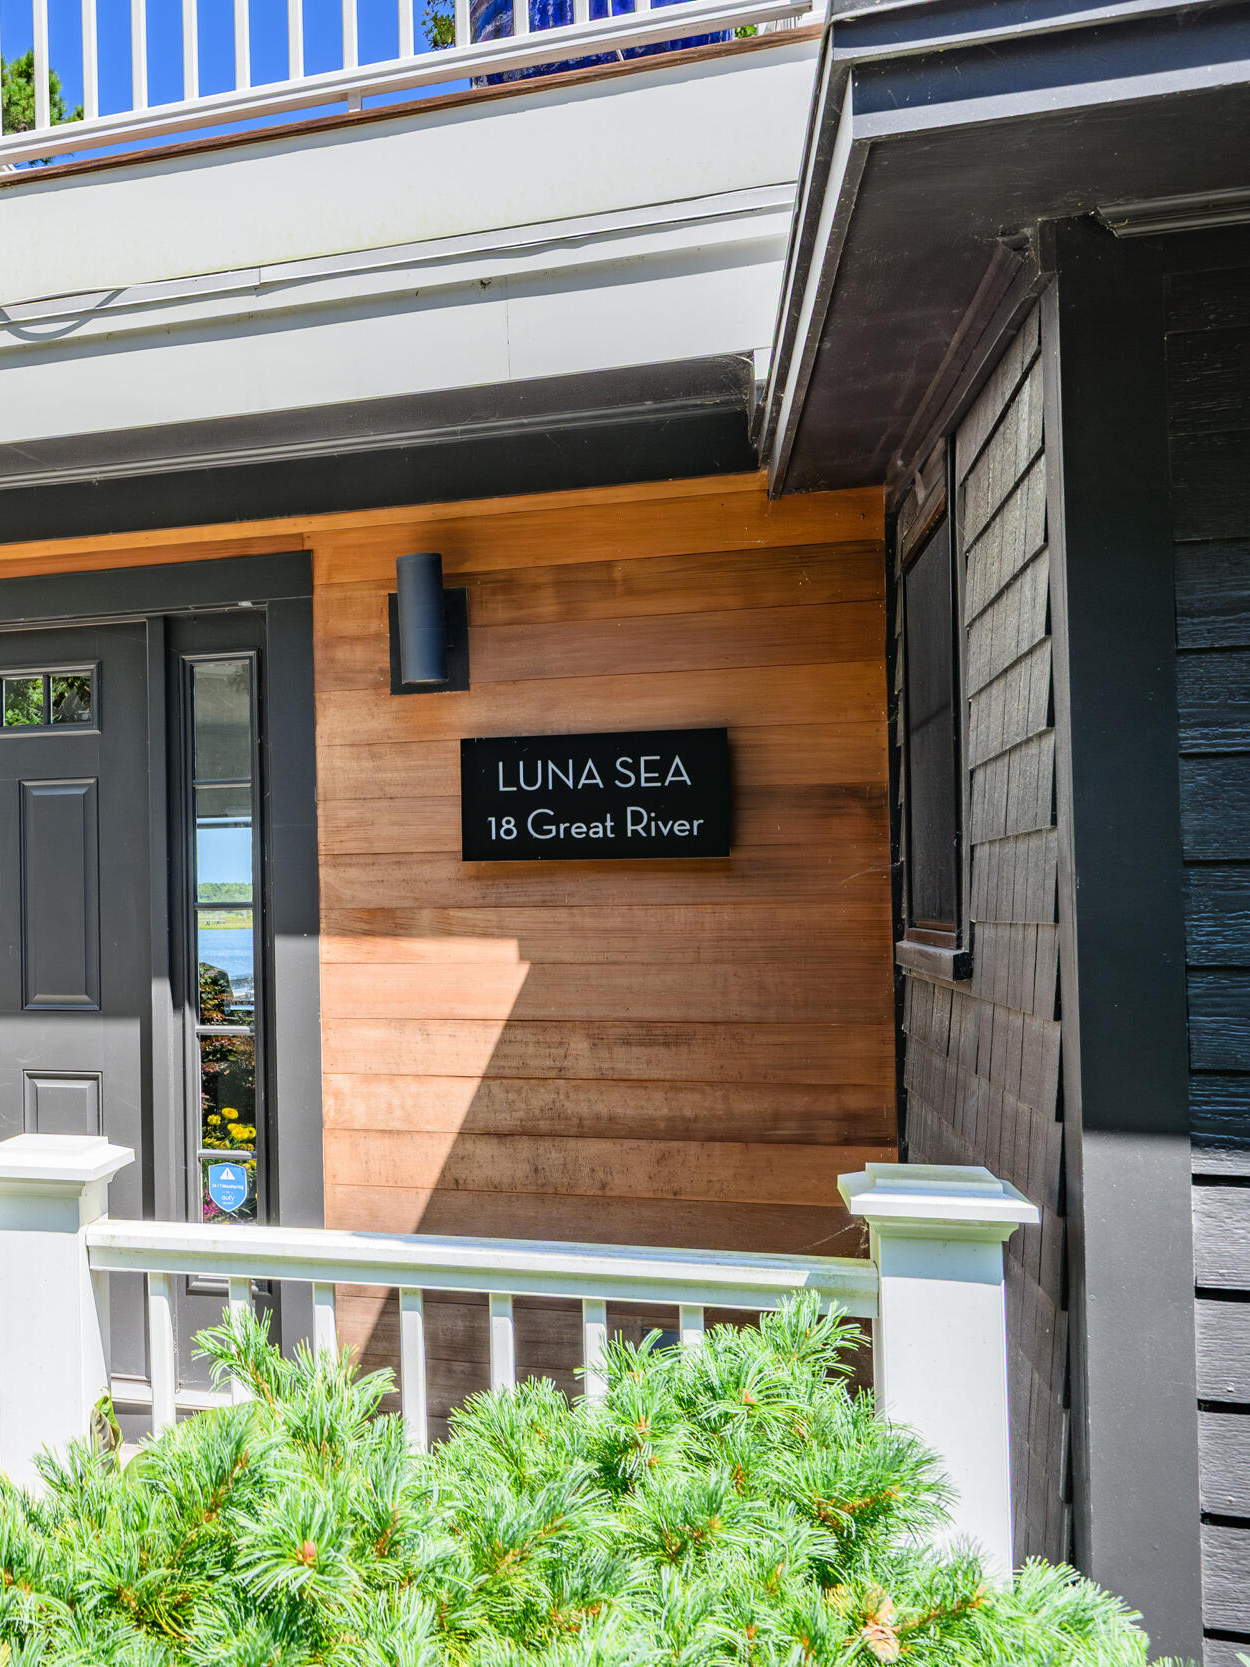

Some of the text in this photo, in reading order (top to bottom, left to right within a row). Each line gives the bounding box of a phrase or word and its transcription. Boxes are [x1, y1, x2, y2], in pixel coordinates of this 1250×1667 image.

[498, 754, 692, 792] LUNA SEA
[487, 806, 704, 841] 18 Great River
